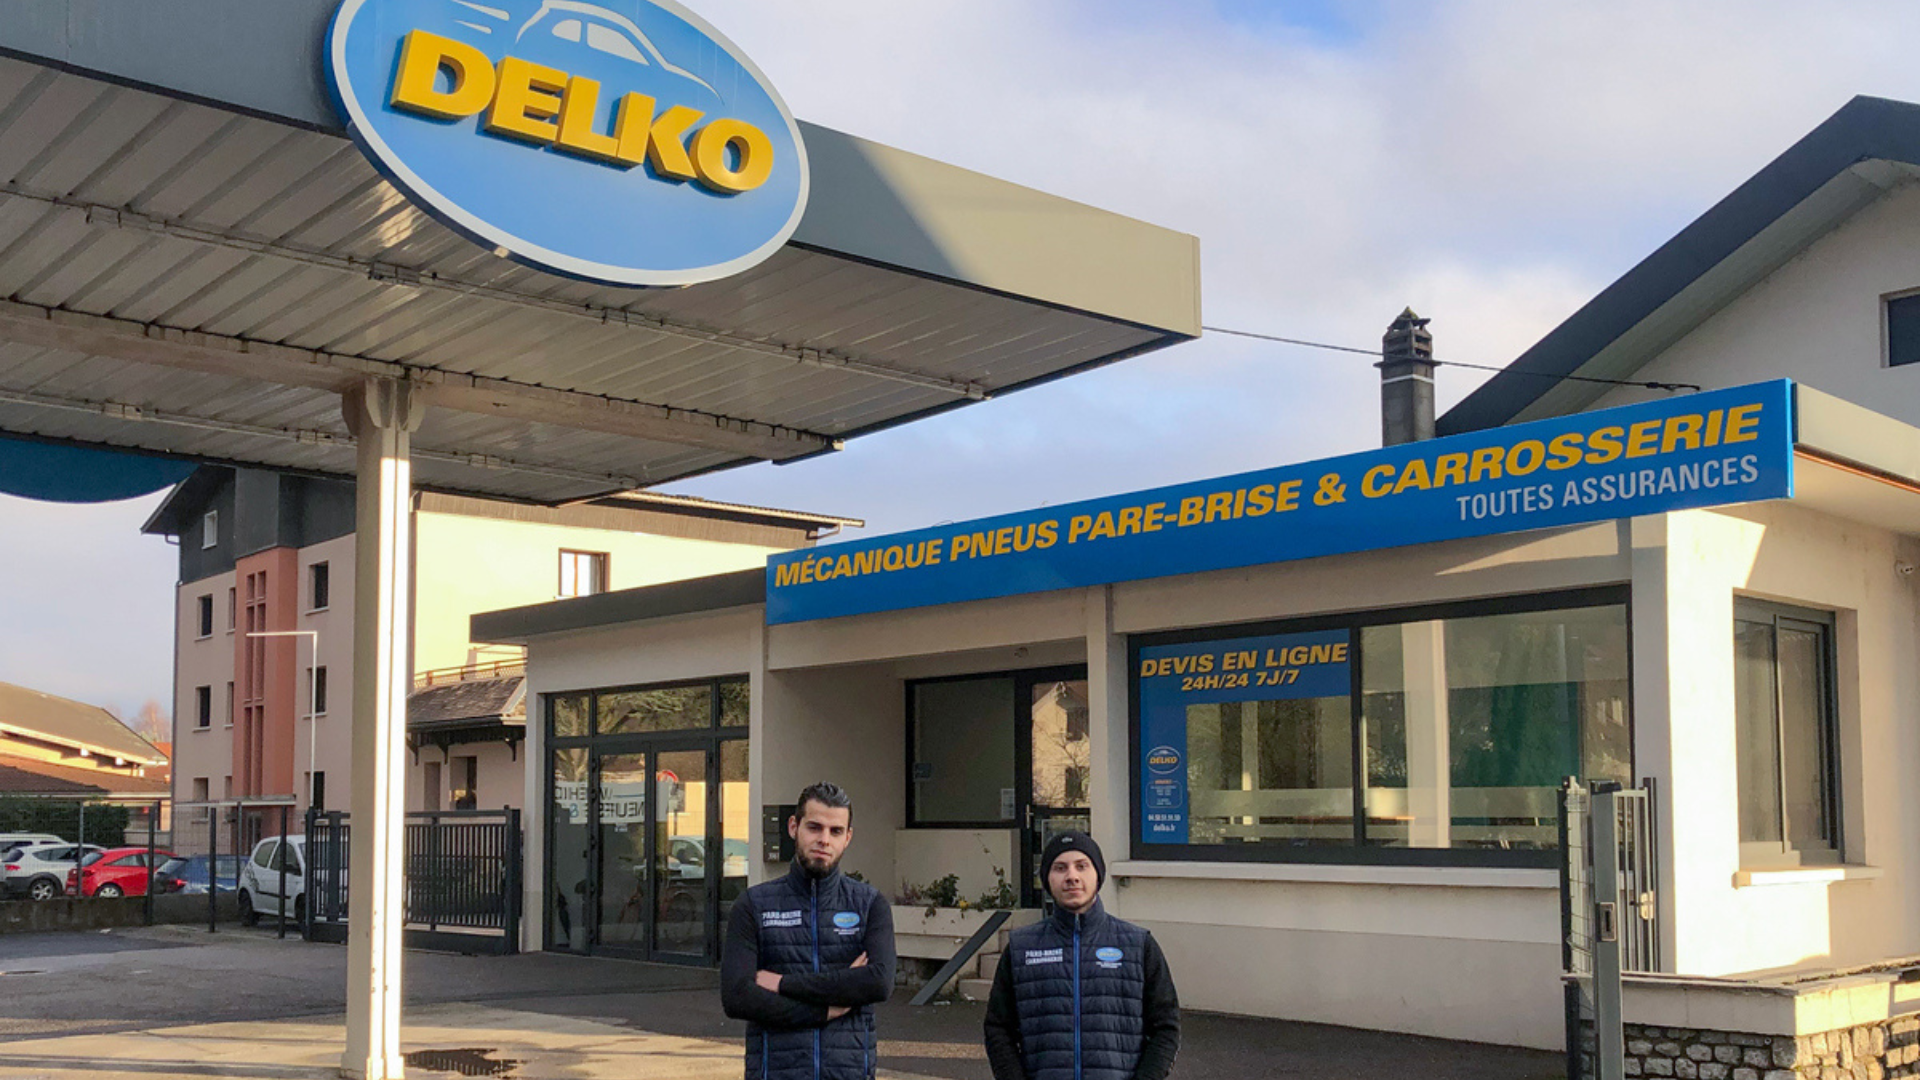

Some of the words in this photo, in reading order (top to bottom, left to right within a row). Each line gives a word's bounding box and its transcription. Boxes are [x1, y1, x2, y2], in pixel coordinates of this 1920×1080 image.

[389, 28, 775, 194] DELKO
[774, 537, 943, 588] MÉCANIQUE
[950, 520, 1060, 562] PNEUS
[1067, 477, 1302, 544] PARE-BRISE
[1313, 472, 1347, 506] &
[1360, 403, 1763, 497] CARROSSERIE
[1456, 483, 1554, 522] TOUTES
[1561, 454, 1759, 508] ASSURANCES
[1140, 654, 1214, 677] DEVIS
[1222, 650, 1258, 671] EN
[1265, 643, 1349, 667] LIGNE
[1181, 672, 1249, 691] 24H/24
[1256, 669, 1300, 686] 7J/7
